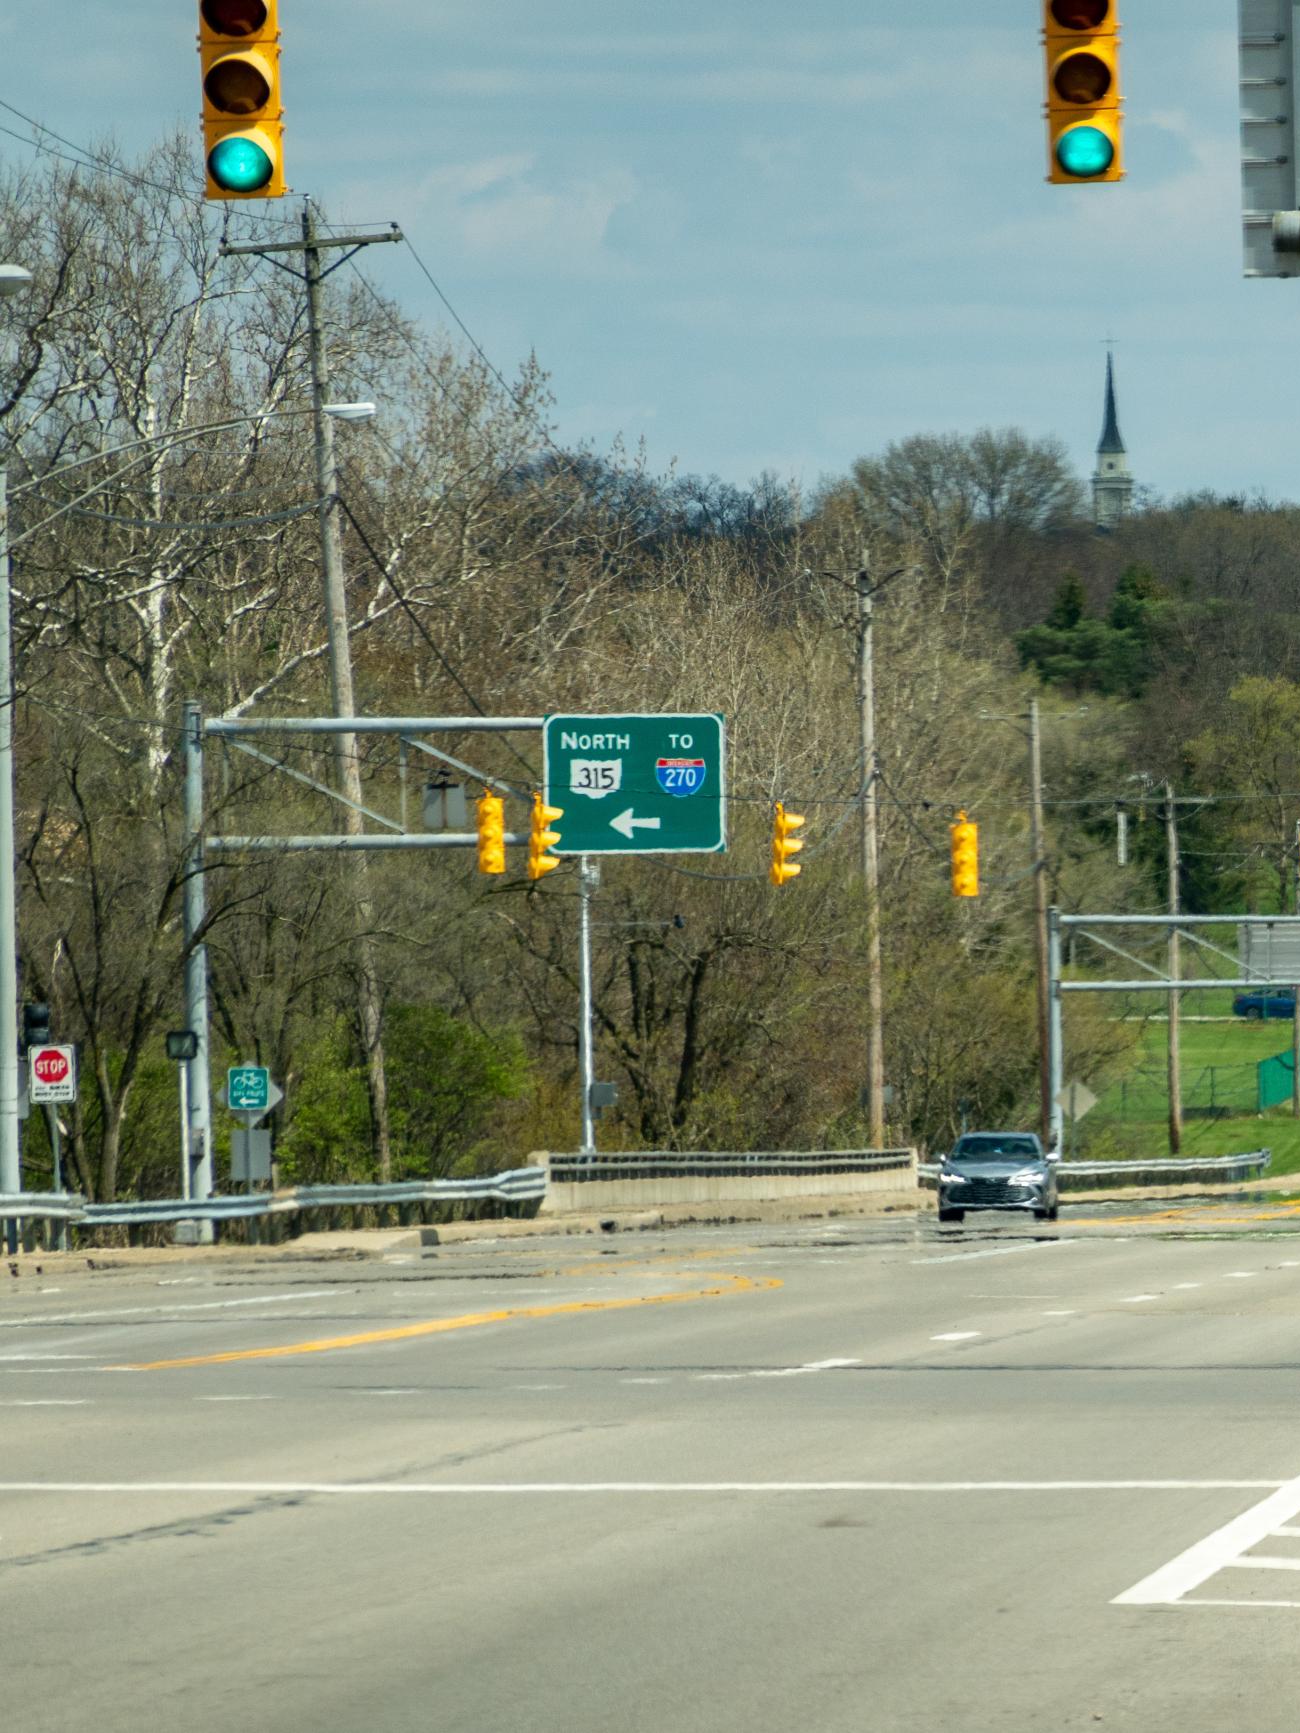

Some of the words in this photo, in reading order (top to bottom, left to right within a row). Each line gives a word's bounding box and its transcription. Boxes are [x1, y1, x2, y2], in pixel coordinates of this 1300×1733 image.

[561, 732, 630, 749] NORTH
[668, 734, 693, 748] TO
[578, 767, 613, 789] 315
[665, 769, 696, 787] 270
[36, 1059, 66, 1074] STOP
